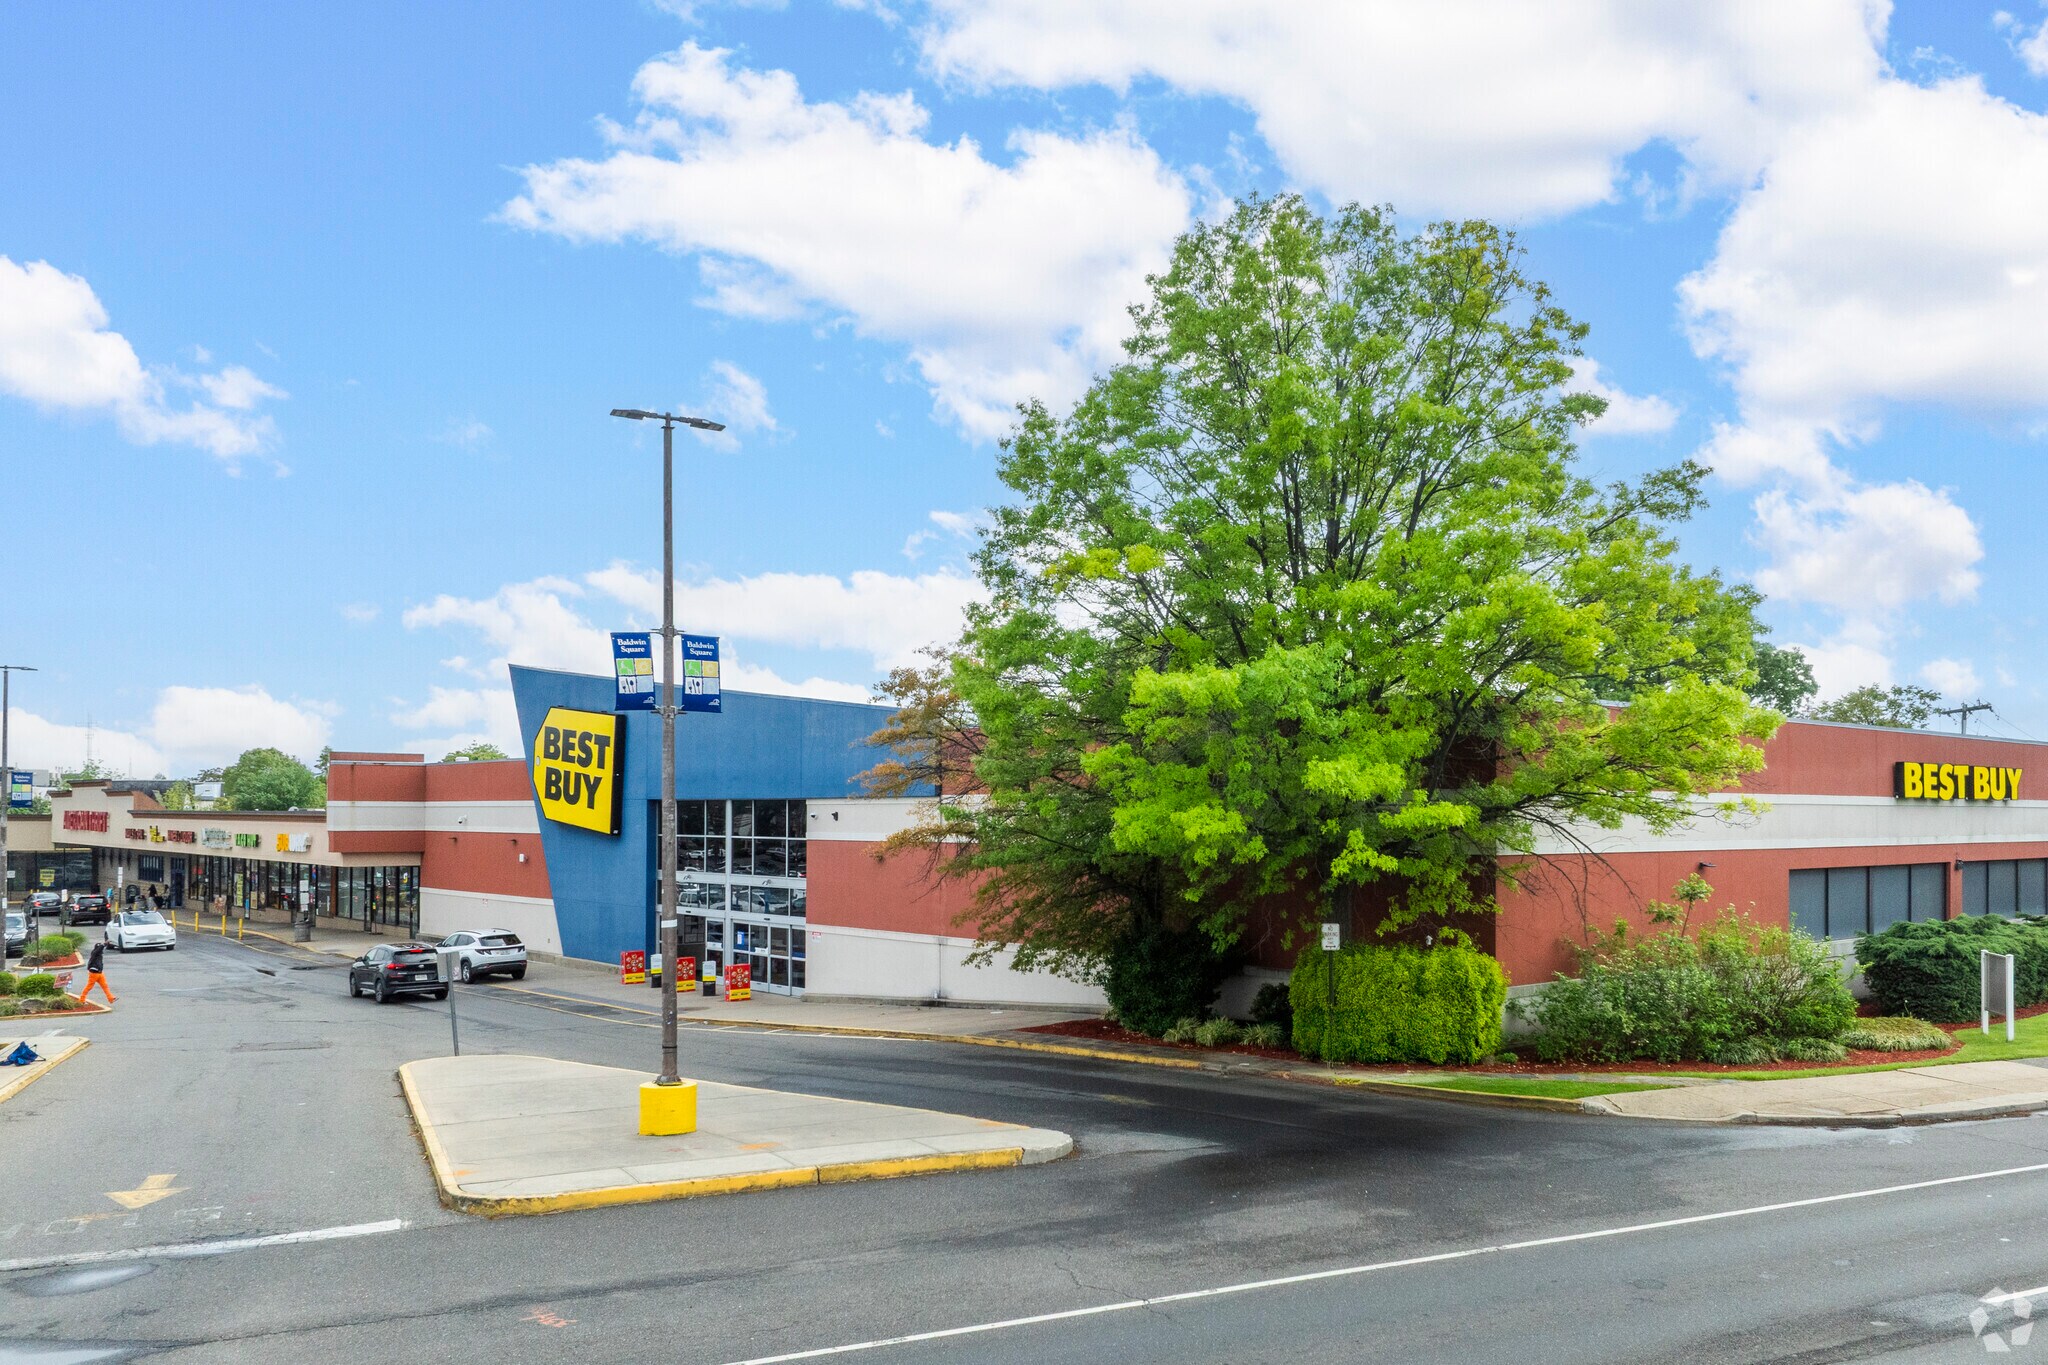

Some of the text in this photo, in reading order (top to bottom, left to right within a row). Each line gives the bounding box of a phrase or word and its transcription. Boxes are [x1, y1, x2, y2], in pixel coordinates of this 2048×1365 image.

[617, 638, 647, 646] Baldwin
[687, 640, 715, 650] Baldwin
[690, 648, 713, 656] Square
[543, 726, 611, 770] BEST
[544, 766, 603, 810] BUY
[1904, 761, 2023, 801] BEST BUY
